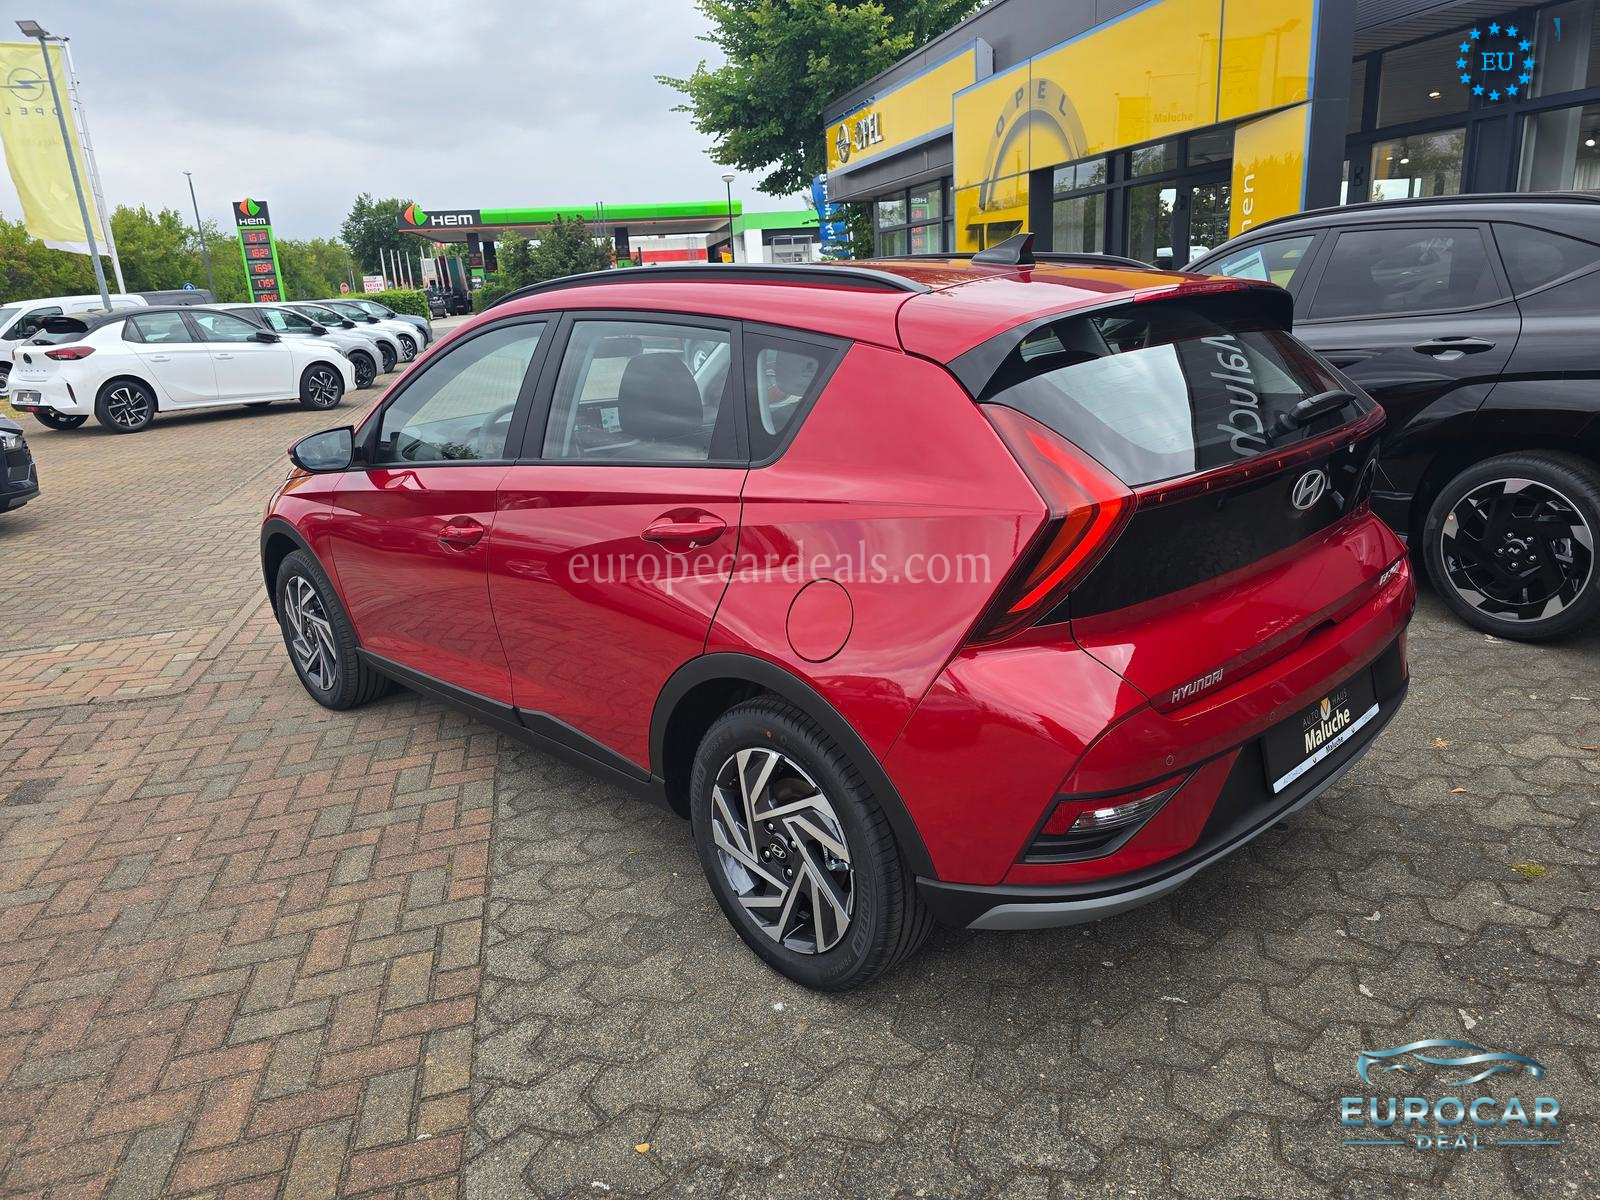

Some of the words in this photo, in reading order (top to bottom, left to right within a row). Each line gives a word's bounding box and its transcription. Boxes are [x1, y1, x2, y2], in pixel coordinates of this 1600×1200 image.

[996, 79, 1066, 138] OPEL
[1153, 111, 1193, 123] Maluche
[854, 112, 884, 150] OPEL
[1171, 668, 1224, 703] HYUNDAI
[1304, 708, 1350, 754] Maluche
[1325, 736, 1344, 754] Maluche
